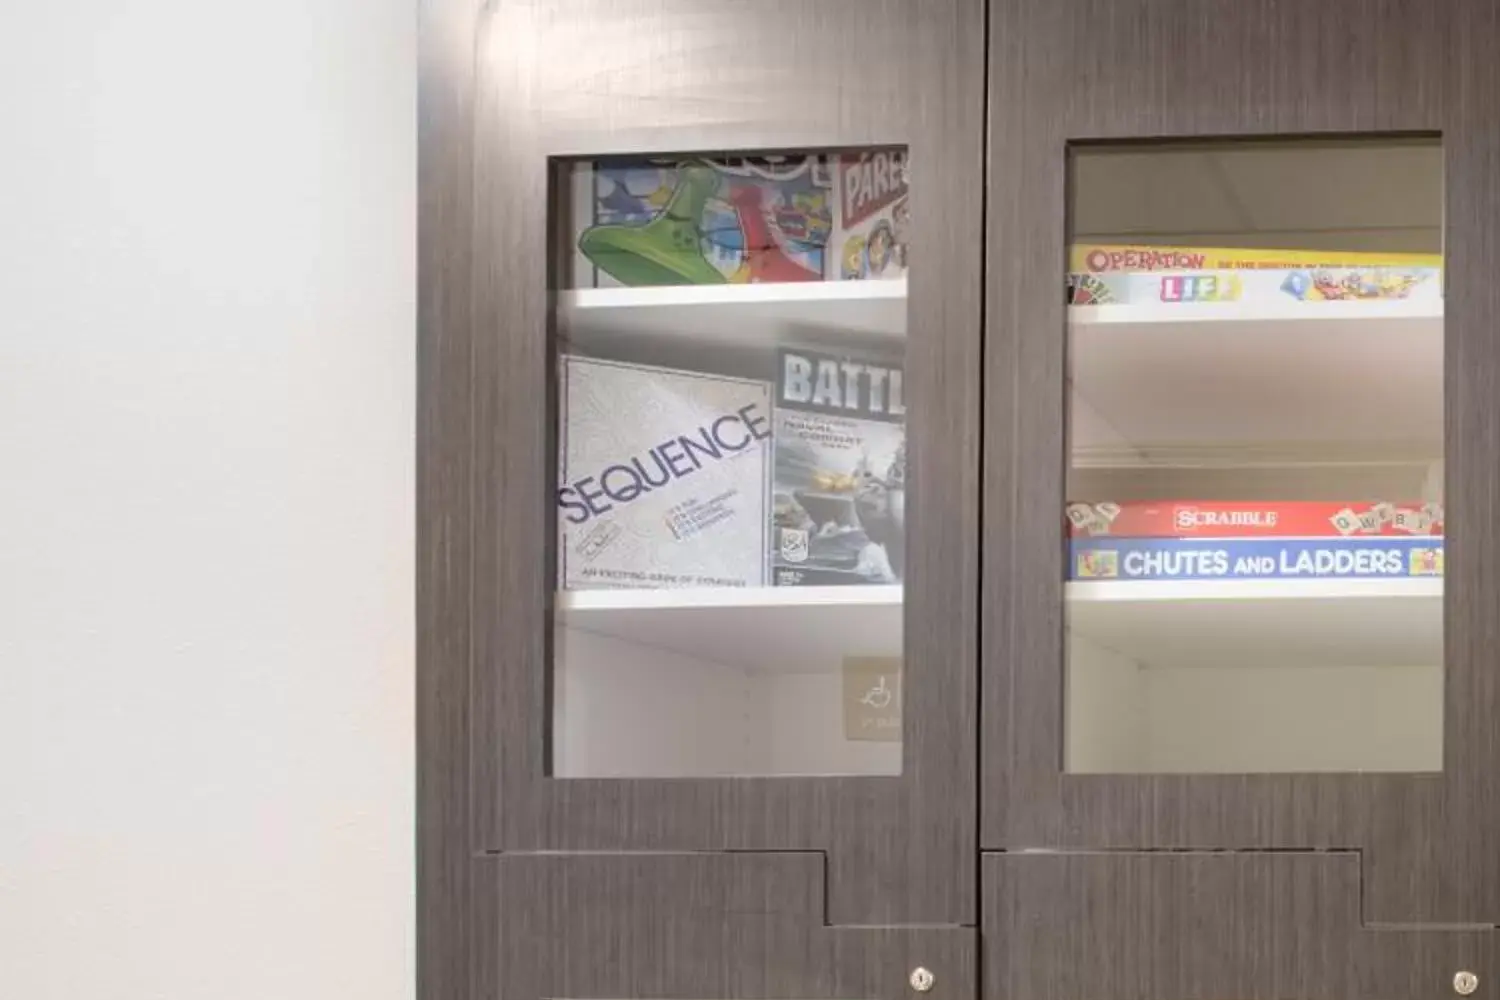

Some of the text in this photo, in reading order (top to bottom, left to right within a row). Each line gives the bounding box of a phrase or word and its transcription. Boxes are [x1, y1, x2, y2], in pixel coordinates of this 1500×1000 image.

[1086, 249, 1205, 272] OPERATION
[558, 404, 772, 524] SEQUENCE
[1178, 509, 1277, 527] SCRABBLE
[1124, 549, 1403, 575] CHUTES AND LADDERS
